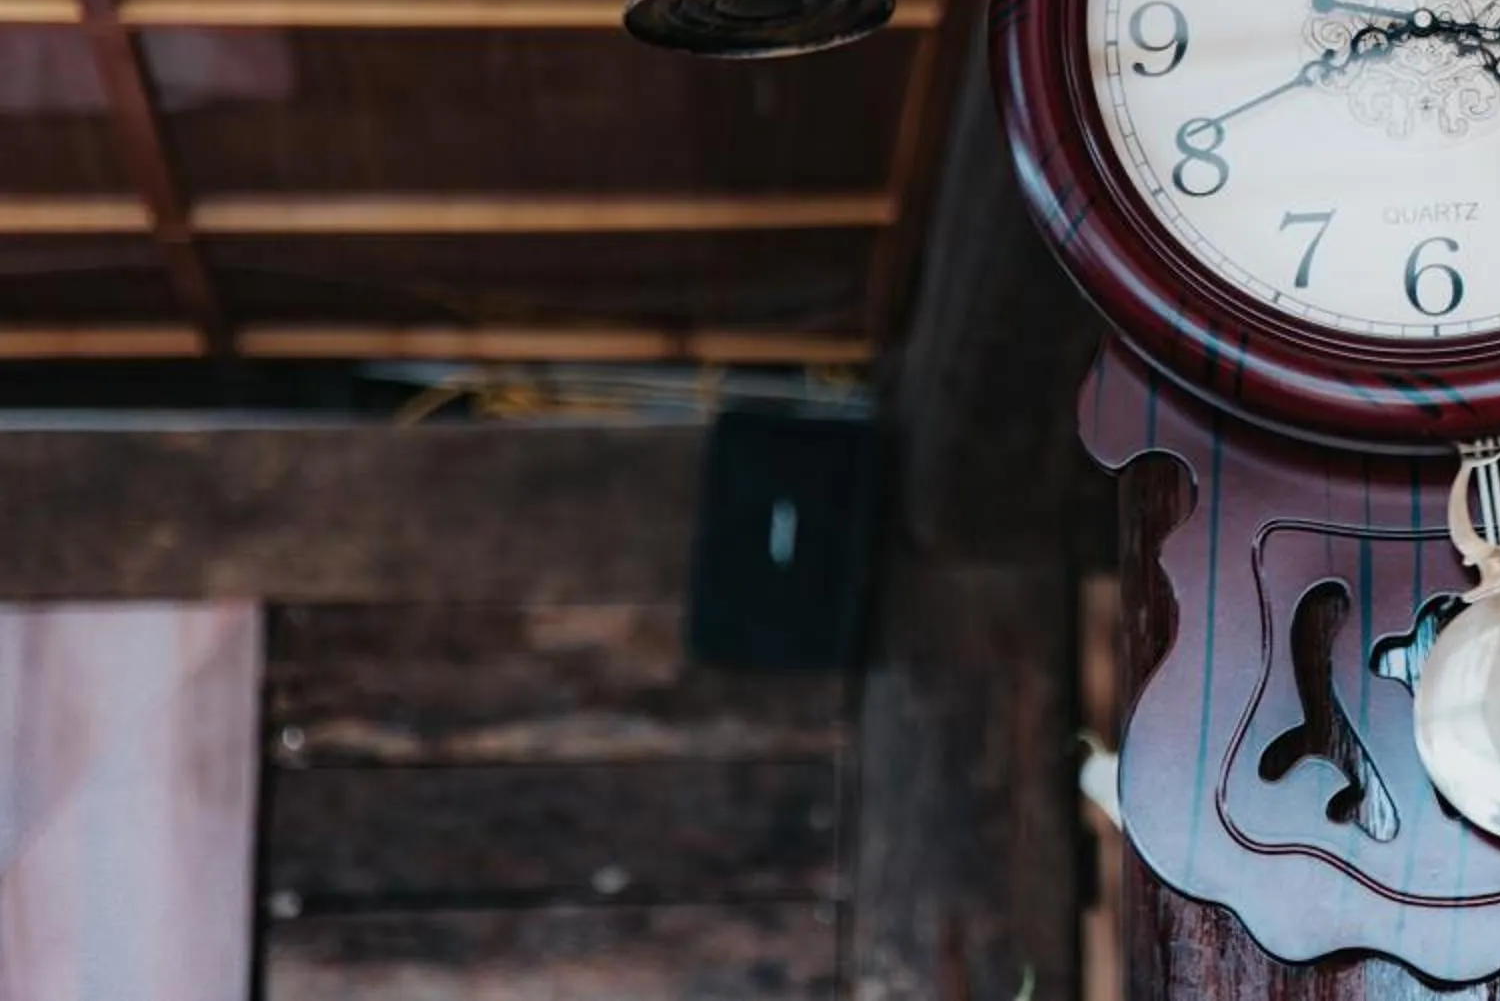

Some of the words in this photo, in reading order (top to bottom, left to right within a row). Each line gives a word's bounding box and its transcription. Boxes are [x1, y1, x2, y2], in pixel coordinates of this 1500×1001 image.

[1128, 2, 1190, 78] 9
[1172, 119, 1230, 197] 8
[1278, 209, 1338, 289] 7
[1382, 201, 1479, 225] QUARTZ
[1403, 236, 1466, 318] 6
